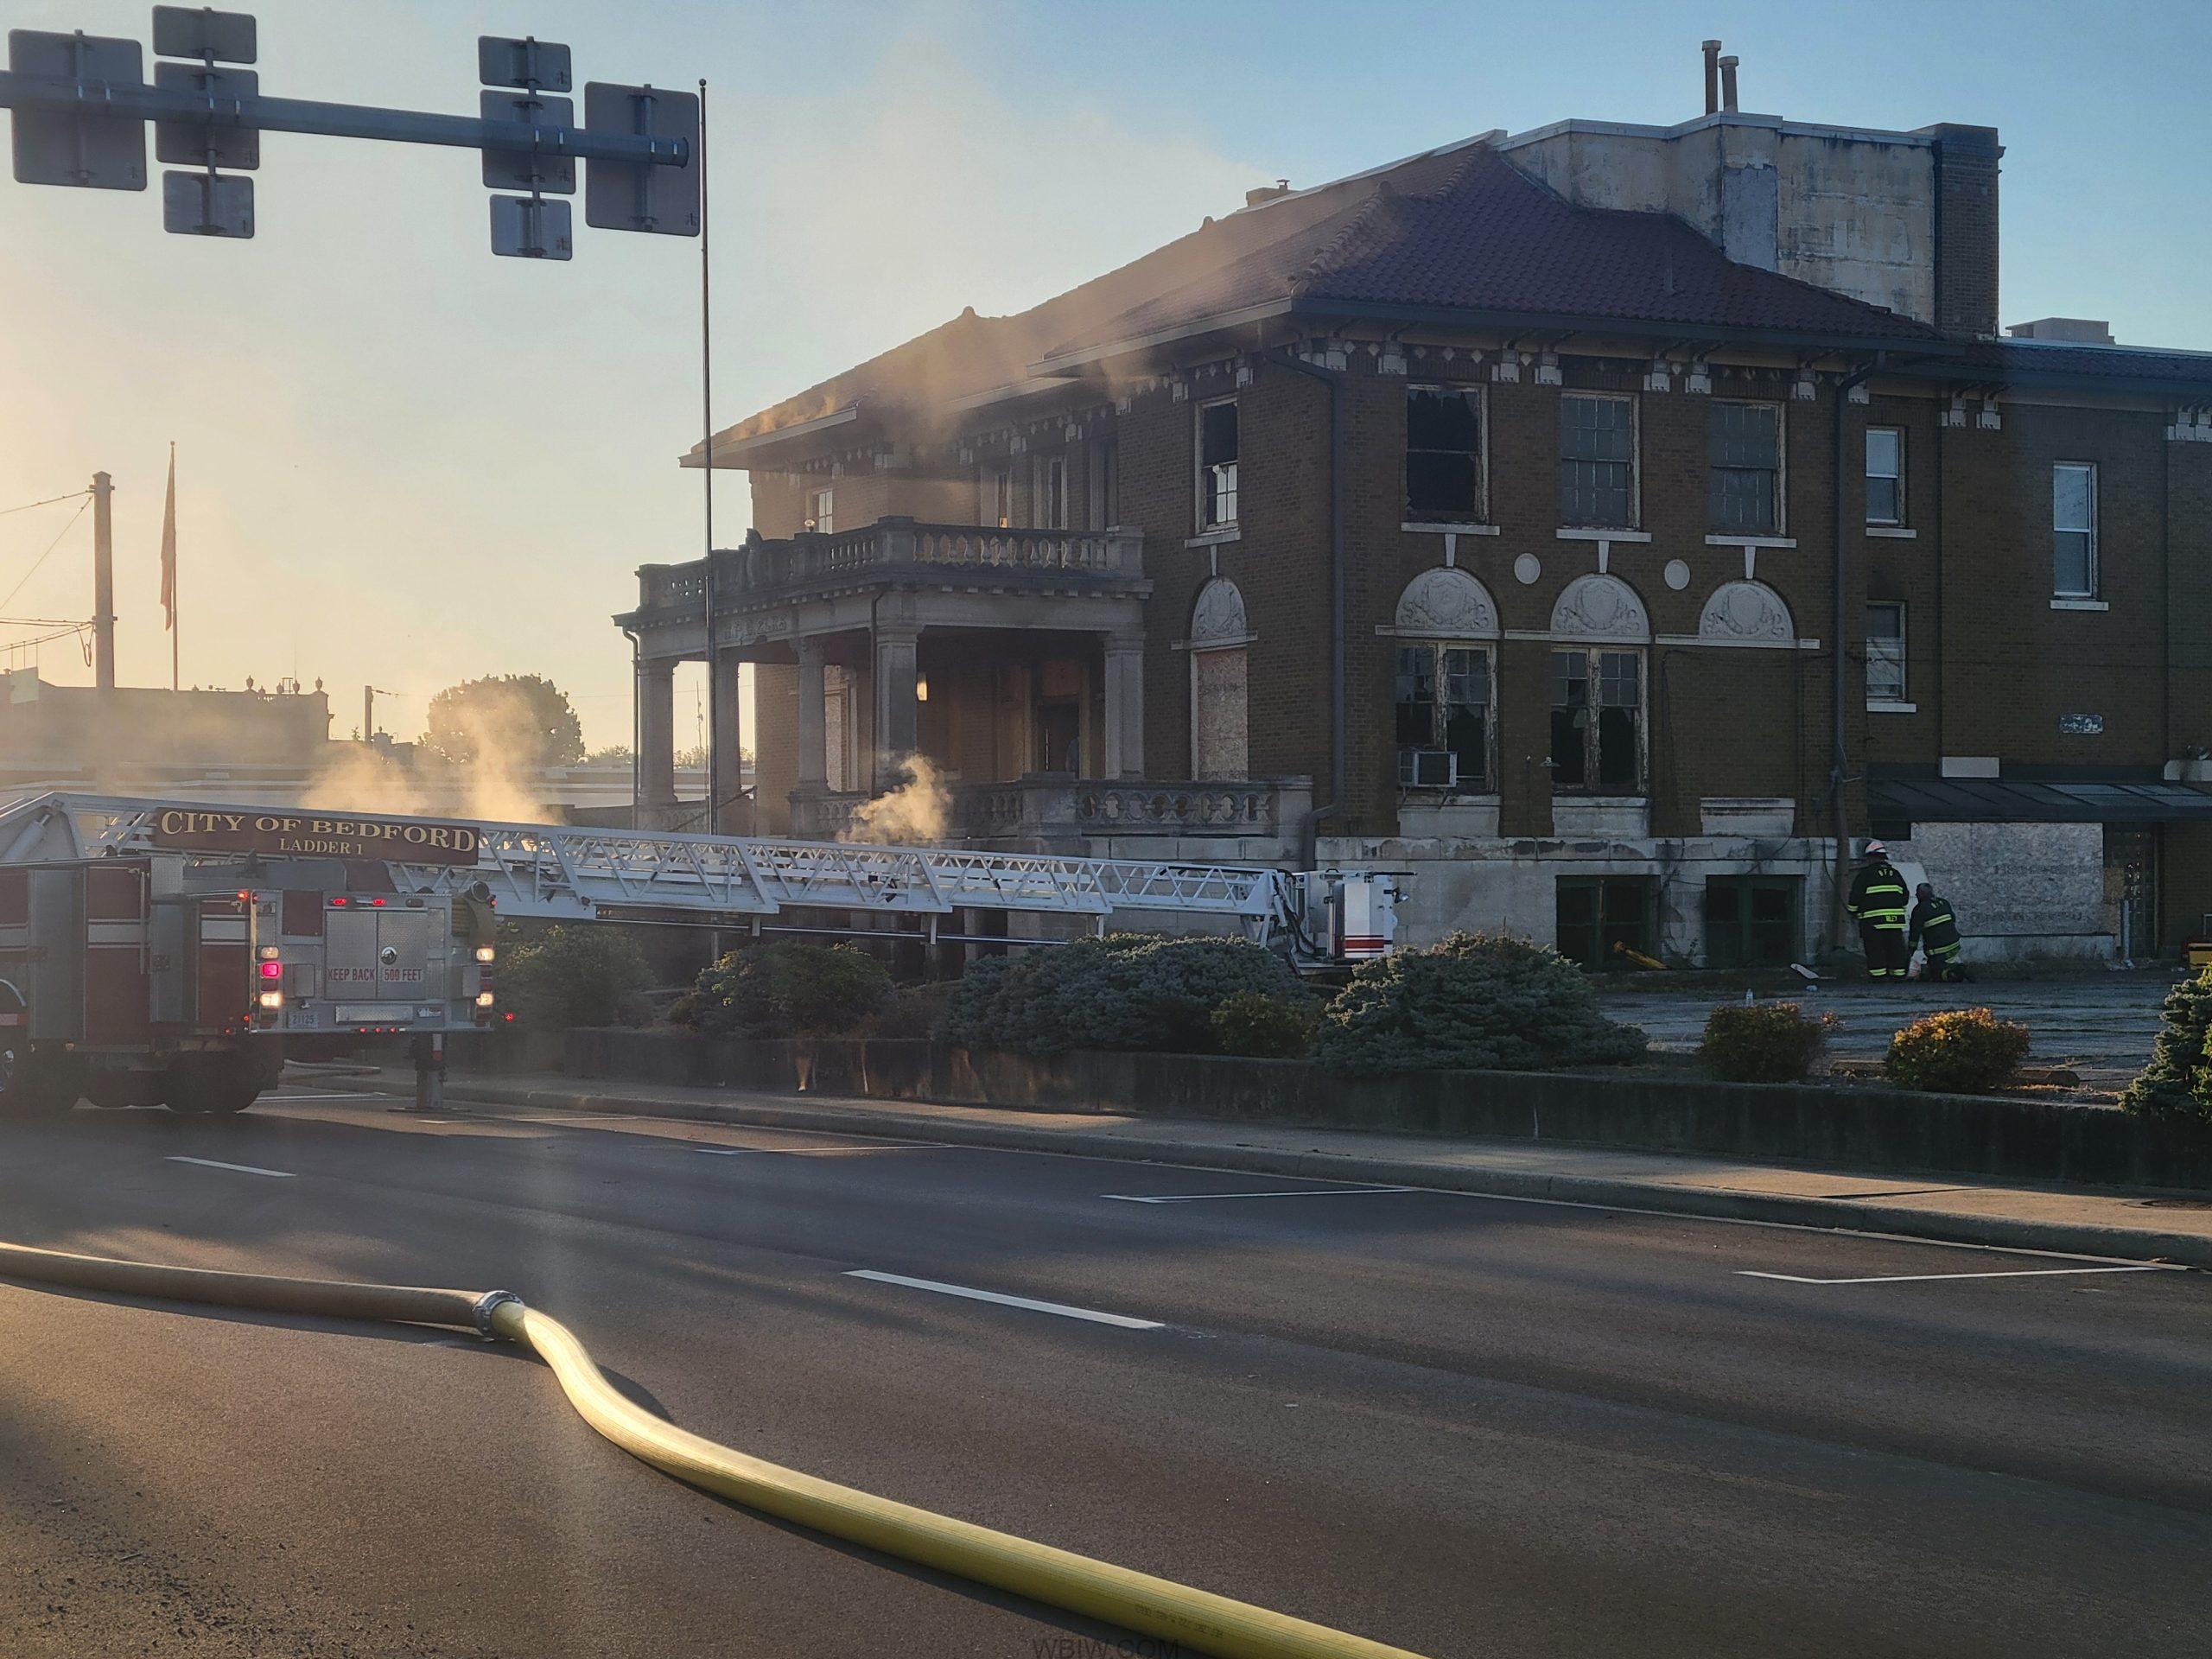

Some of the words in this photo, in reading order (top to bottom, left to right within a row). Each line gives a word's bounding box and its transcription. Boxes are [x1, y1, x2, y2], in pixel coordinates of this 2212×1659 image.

[161, 810, 246, 835] CITY
[255, 817, 302, 832] OF
[310, 820, 475, 852] BEDFORD
[280, 838, 351, 854] LADDER
[357, 843, 363, 855] 1
[327, 969, 350, 981] KEEP
[353, 969, 375, 981] BACK
[385, 969, 399, 981] 500
[403, 969, 422, 981] FEET
